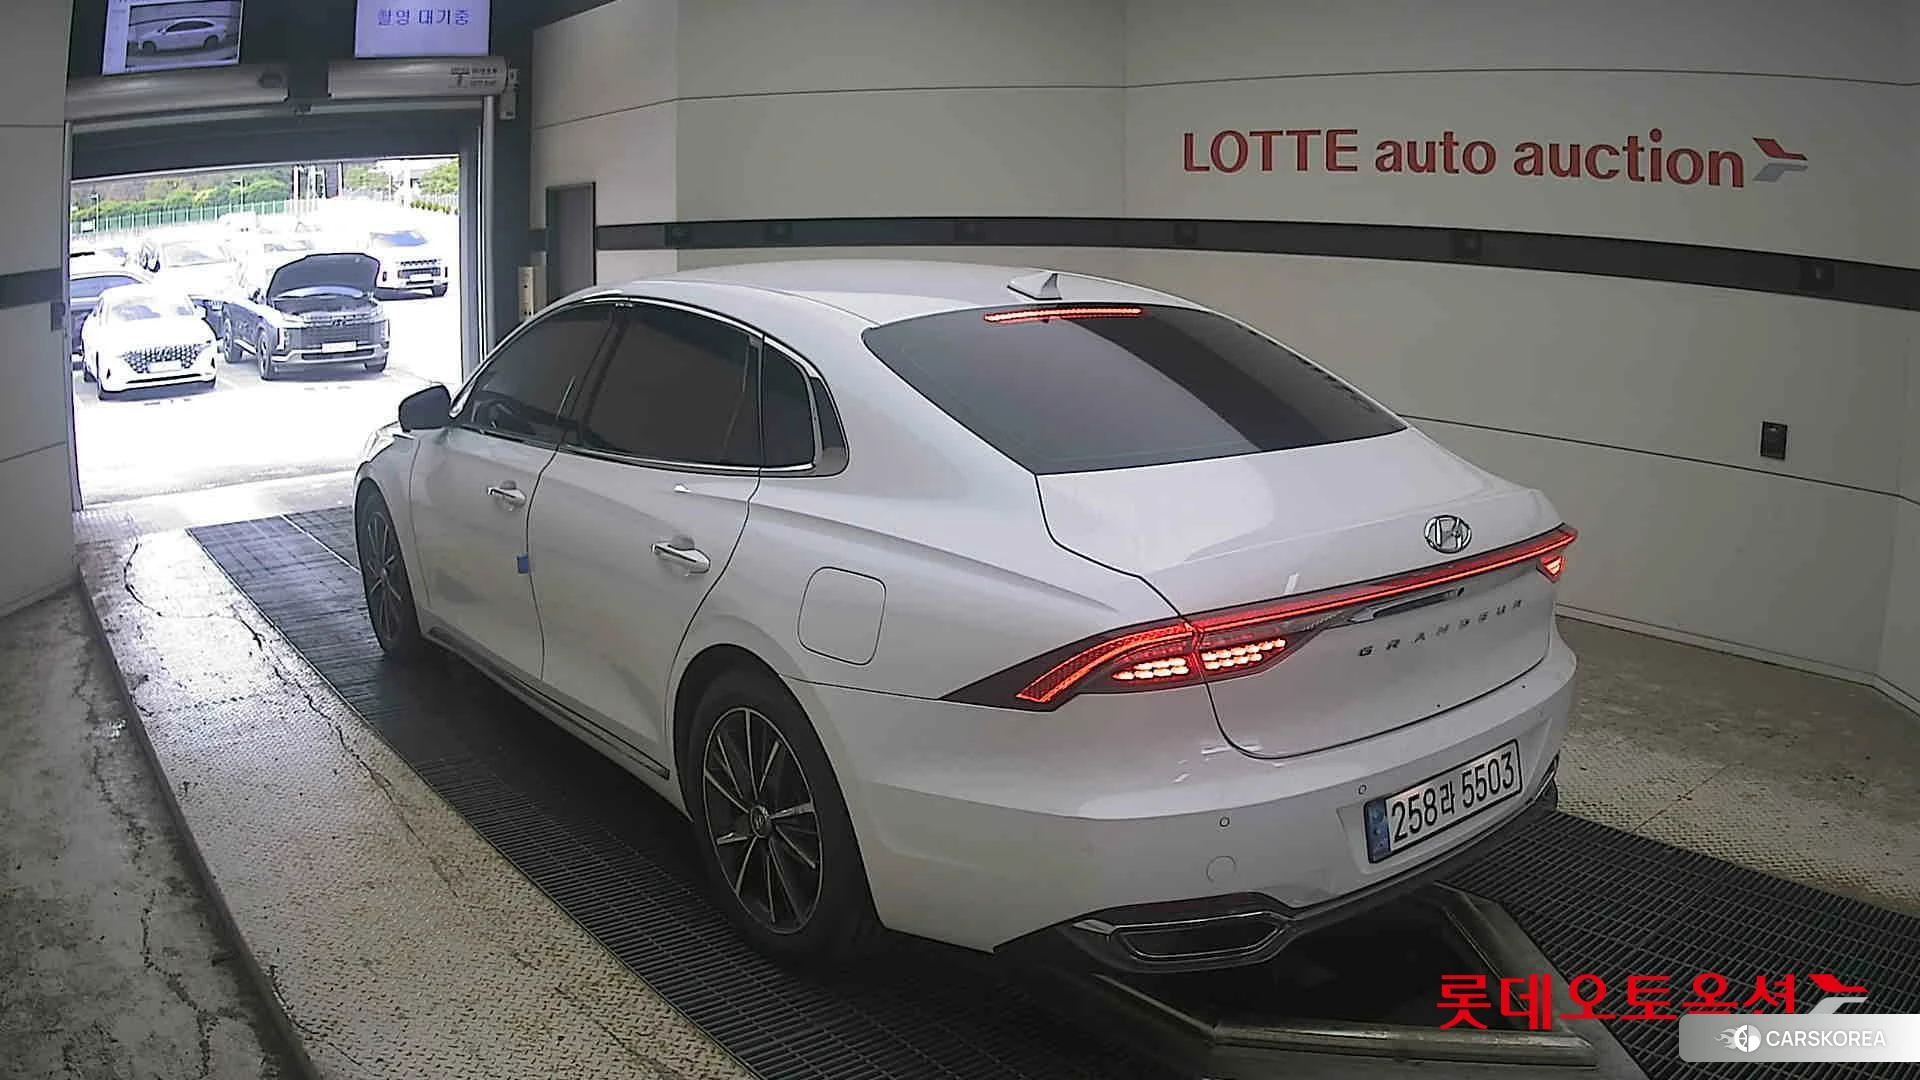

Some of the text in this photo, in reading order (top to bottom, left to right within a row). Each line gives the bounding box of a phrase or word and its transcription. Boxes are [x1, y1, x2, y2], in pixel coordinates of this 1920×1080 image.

[418, 9, 470, 26] 대기중
[1183, 128, 1745, 188] LOTTE auto auction
[1391, 751, 1515, 843] 258라 5503
